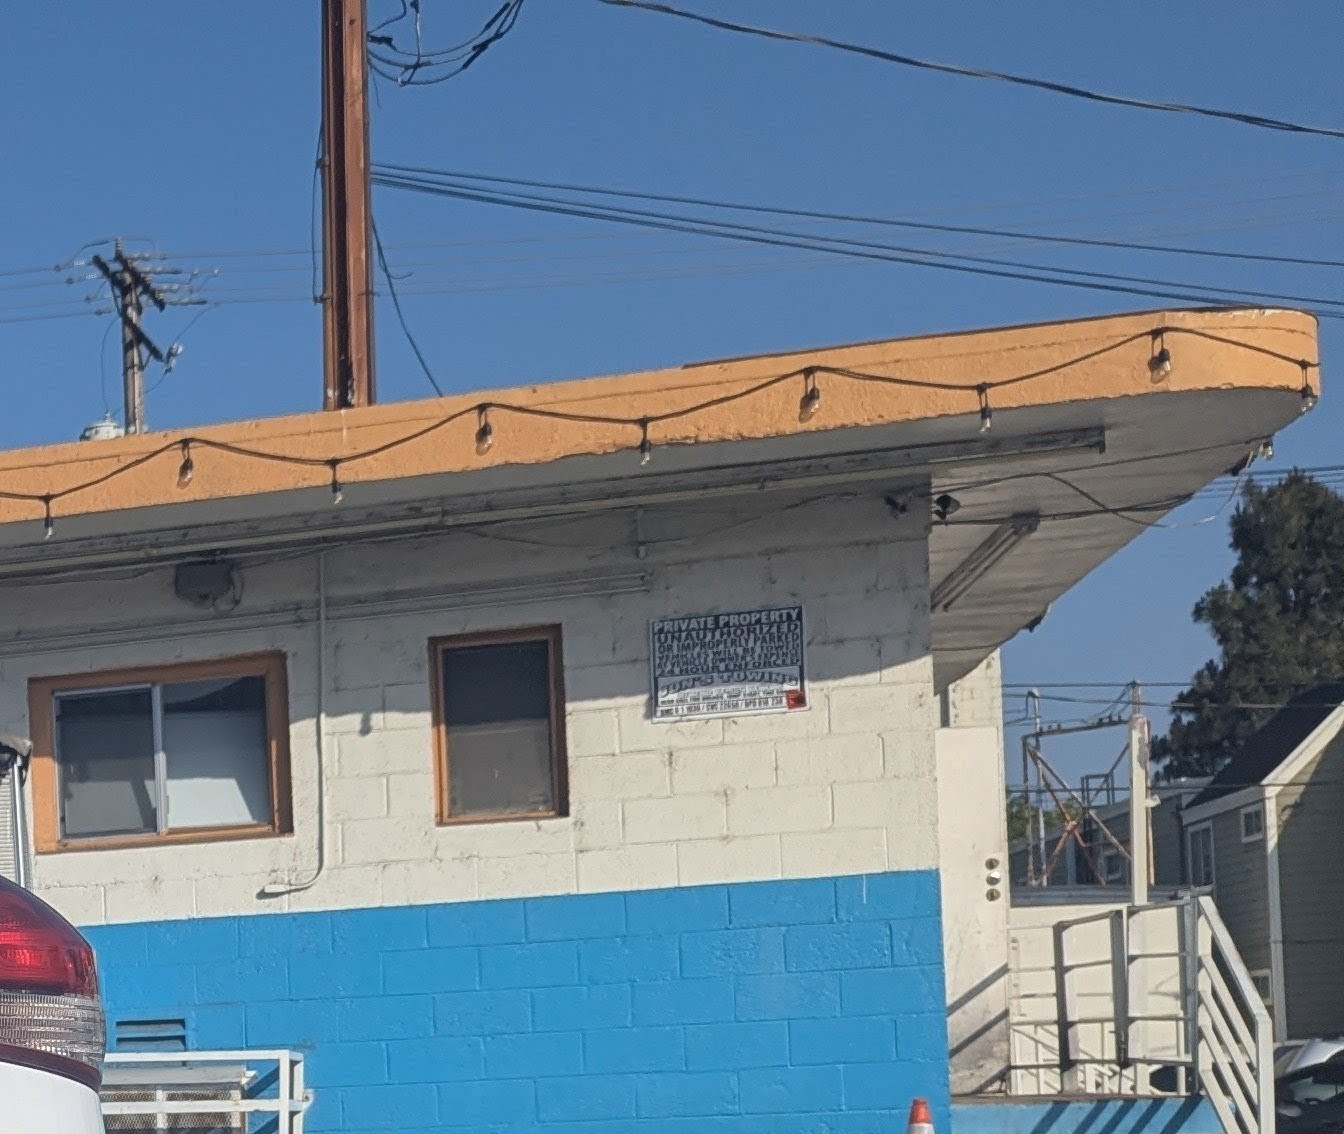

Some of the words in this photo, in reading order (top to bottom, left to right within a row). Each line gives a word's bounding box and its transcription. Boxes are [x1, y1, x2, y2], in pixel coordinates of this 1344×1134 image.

[653, 615, 715, 633] PRIVATE
[718, 607, 800, 627] PROPERTY
[657, 621, 799, 644] UNAUTHORIZED
[657, 643, 673, 654] OR
[676, 636, 749, 653] IMPROPERLY
[753, 631, 799, 645] PARKED
